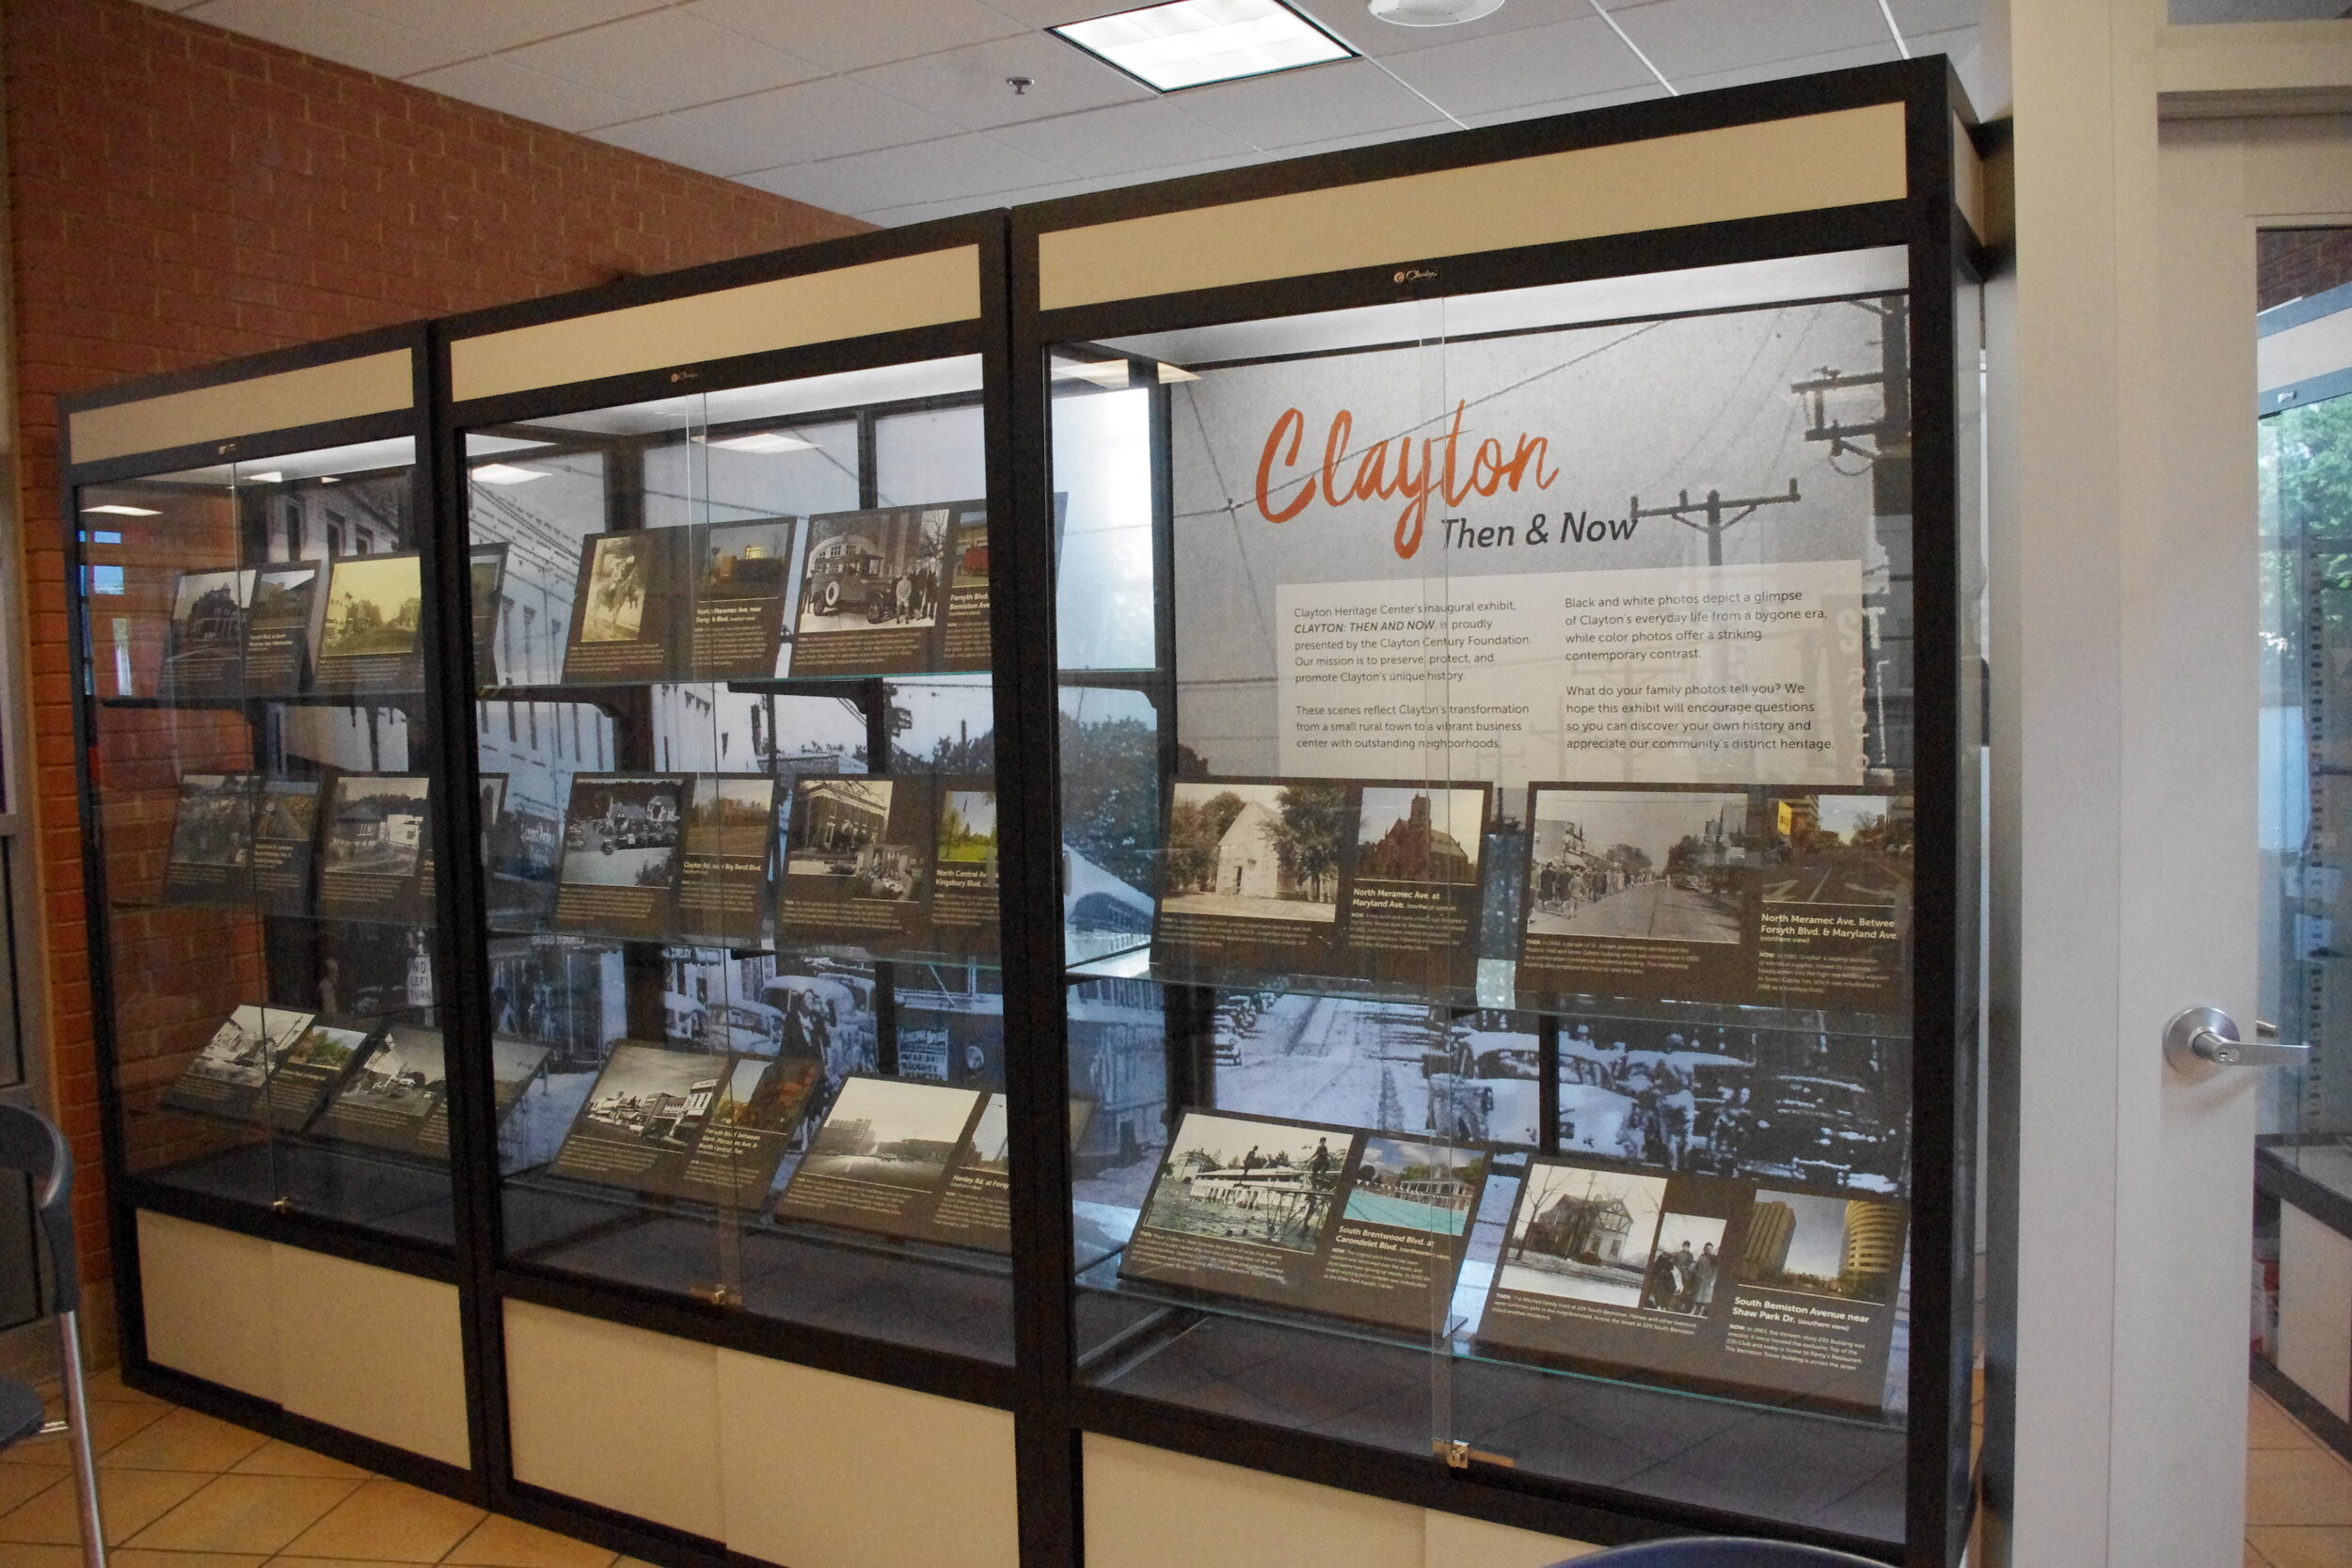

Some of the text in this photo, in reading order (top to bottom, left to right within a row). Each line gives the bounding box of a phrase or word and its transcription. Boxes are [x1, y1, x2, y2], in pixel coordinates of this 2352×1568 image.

[1254, 399, 1560, 560] Clayton
[1442, 510, 1638, 551] Then & Now
[950, 594, 974, 602] Forsyth
[1565, 591, 1803, 609] Black and white photos depict a glimpse
[1294, 601, 1517, 619] Clayton Heritage Center's inaugural exhibit,
[1565, 615, 1578, 626] of
[1580, 614, 1632, 627] Clayton's
[1635, 612, 1687, 626] everyday
[1691, 611, 1708, 623] life
[1711, 611, 1740, 622] from
[1744, 612, 1751, 621] a
[1755, 610, 1802, 623] bygone
[1294, 624, 1346, 634] CLAYTON:
[1349, 622, 1378, 632] THEN
[1380, 621, 1405, 631] AND
[1439, 622, 1449, 630] is
[1452, 619, 1493, 631] proudly
[1565, 628, 1762, 644] while color photos offer a striking
[1295, 641, 1344, 652] presented
[1346, 640, 1359, 651] by
[1360, 640, 1377, 649] the
[1380, 638, 1420, 649] Clayton
[1422, 637, 1465, 648] Century
[1295, 657, 1314, 667] Our
[1316, 656, 1354, 666] mission
[1357, 656, 1364, 665] is
[1366, 656, 1377, 665] to
[1429, 654, 1470, 665] protect,
[1474, 653, 1494, 662] and
[1565, 650, 1646, 663] contemporary
[1295, 673, 1338, 685] promote
[1340, 672, 1387, 684] Clayton's
[1389, 672, 1424, 683] unique
[1565, 683, 1804, 698] What do your family photos tell you? We
[1296, 704, 1530, 716] These scenes reflect Clayton's transformation
[1565, 702, 1815, 716] hope this exhibit will encourage questions
[1296, 721, 1320, 732] from
[1330, 721, 1357, 732] small
[1359, 721, 1383, 731] rural
[1385, 722, 1411, 731] town
[1414, 722, 1425, 731] to
[1436, 721, 1473, 731] vibrant
[1476, 721, 1522, 731] business
[1566, 720, 1811, 734] so you can discover your own history and
[1296, 739, 1327, 748] center
[1330, 738, 1352, 748] with
[1355, 738, 1415, 751] outstanding
[1566, 738, 1627, 752] appreciate
[1629, 740, 1649, 750] our
[1652, 738, 1729, 752] community's
[1732, 737, 1776, 750] distinct
[935, 879, 966, 888] Kingsbury
[1353, 888, 1375, 896] North
[1377, 889, 1413, 898] Meramec
[1352, 898, 1389, 908] Maryland
[1389, 900, 1406, 909] Ave.
[1761, 913, 1896, 928] North Meramec Ave. Betwee
[1760, 925, 1795, 936] Forsyth
[1798, 927, 1820, 936] Blvd.
[1822, 928, 1830, 937] &
[1832, 928, 1877, 939] Maryland
[952, 1174, 974, 1184] Hanley
[1339, 1225, 1362, 1235] South
[1362, 1229, 1406, 1243] Brentwood
[1406, 1236, 1425, 1246] Blvd.
[1335, 1235, 1378, 1249] Carondelet
[1378, 1241, 1398, 1252] Blvd.
[1734, 1296, 1870, 1323] South Bemiston Avenue near
[1732, 1307, 1850, 1332] Shaw Park Dr. (southern view)
